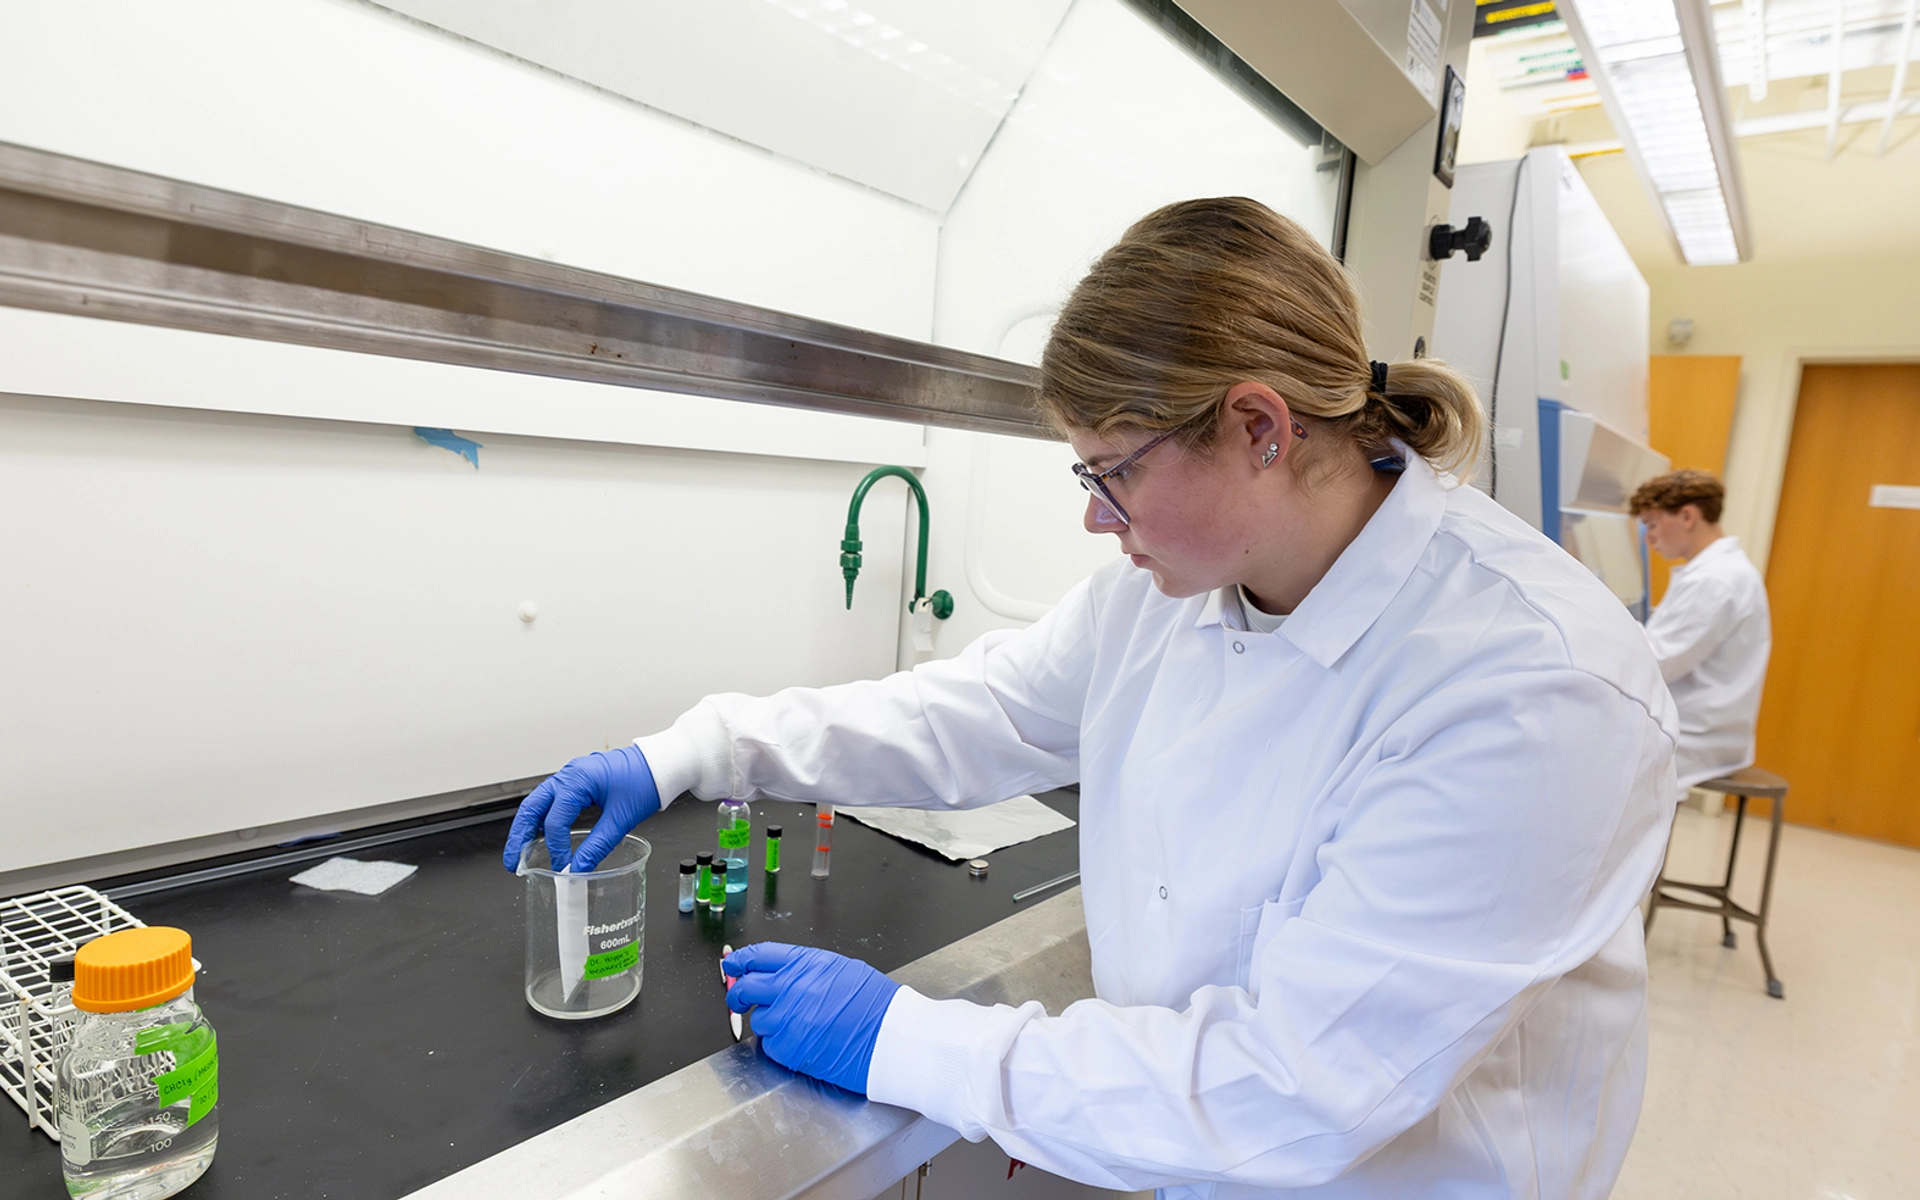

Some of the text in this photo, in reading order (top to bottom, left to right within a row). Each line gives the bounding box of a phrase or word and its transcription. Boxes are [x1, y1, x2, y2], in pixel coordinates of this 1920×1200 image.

[582, 910, 641, 936] Fisherbrand
[600, 934, 631, 950] 600mL
[150, 1137, 172, 1153] 100
